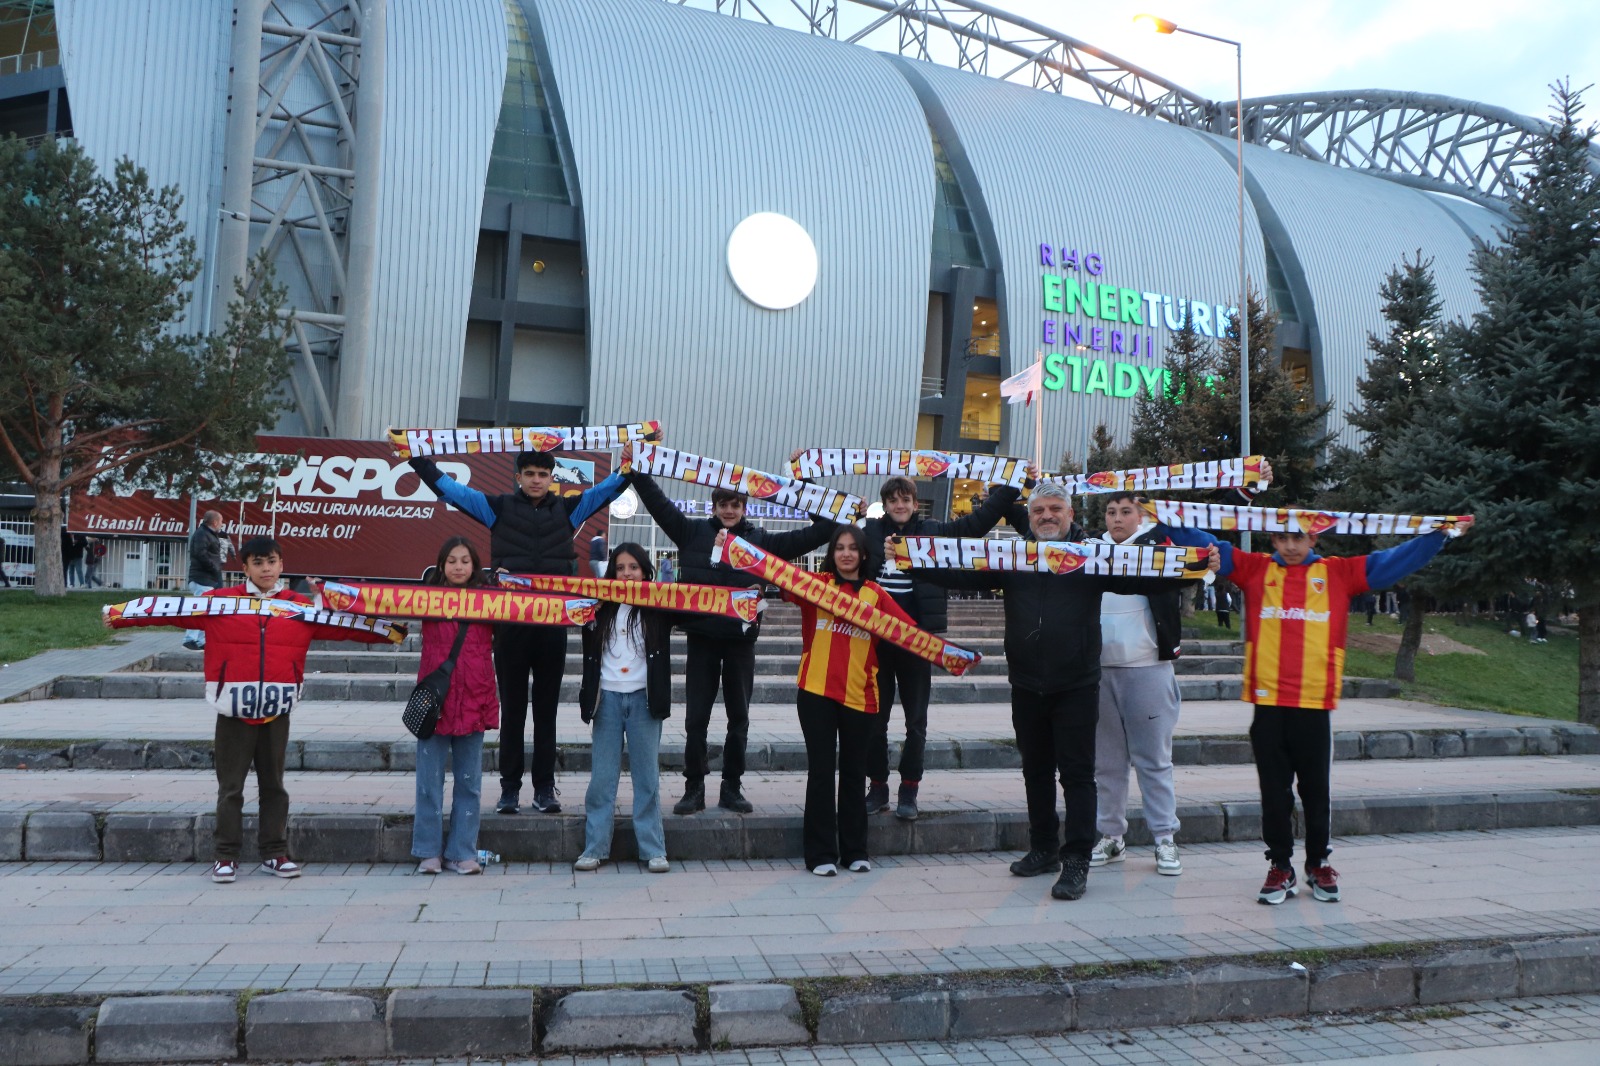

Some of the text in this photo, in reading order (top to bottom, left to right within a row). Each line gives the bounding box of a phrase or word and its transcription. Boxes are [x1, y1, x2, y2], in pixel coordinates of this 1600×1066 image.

[1040, 242, 1104, 276] RHG
[563, 423, 645, 450] KALE
[800, 448, 921, 479] KAPALI
[949, 453, 1029, 490] KALE
[918, 456, 943, 473] KS
[631, 441, 862, 525] KAPALI KALE
[748, 472, 775, 494] KS
[148, 512, 184, 532] Ürün
[279, 522, 328, 538] Destek
[1336, 512, 1446, 535] KALE
[730, 544, 754, 568] KS
[906, 536, 1187, 578] KAPALI KALE
[1048, 548, 1079, 567] KS
[327, 591, 351, 608] KS
[737, 598, 758, 612] KS
[229, 685, 295, 719] 1985
